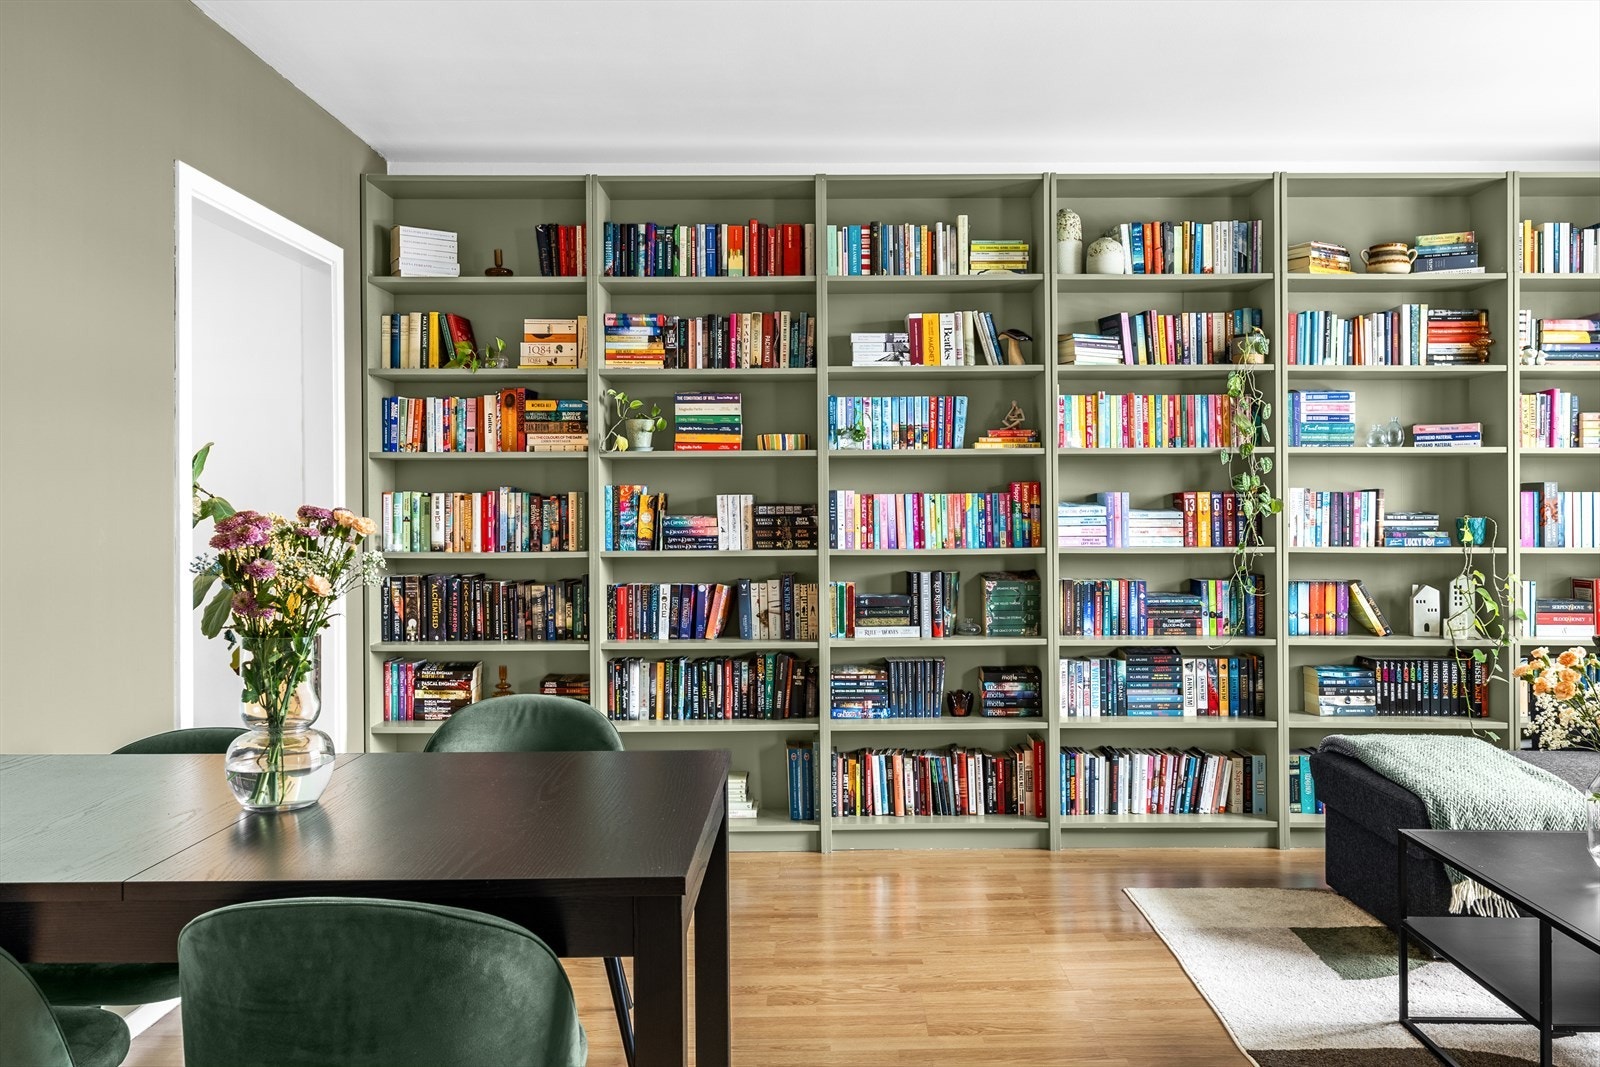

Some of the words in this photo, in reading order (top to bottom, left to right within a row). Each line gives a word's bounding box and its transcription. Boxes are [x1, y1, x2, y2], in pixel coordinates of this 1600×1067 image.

[943, 327, 953, 361] Beatles
[517, 392, 525, 432] GODDESSES
[1185, 499, 1196, 512] 13
[1213, 499, 1220, 511] 6
[1226, 499, 1233, 511] 6
[1404, 537, 1421, 547] LUCKY
[933, 581, 941, 593] RED
[431, 583, 440, 629] ALCHEMISED
[933, 594, 941, 615] RISING
[1234, 770, 1243, 796] Sapiens
